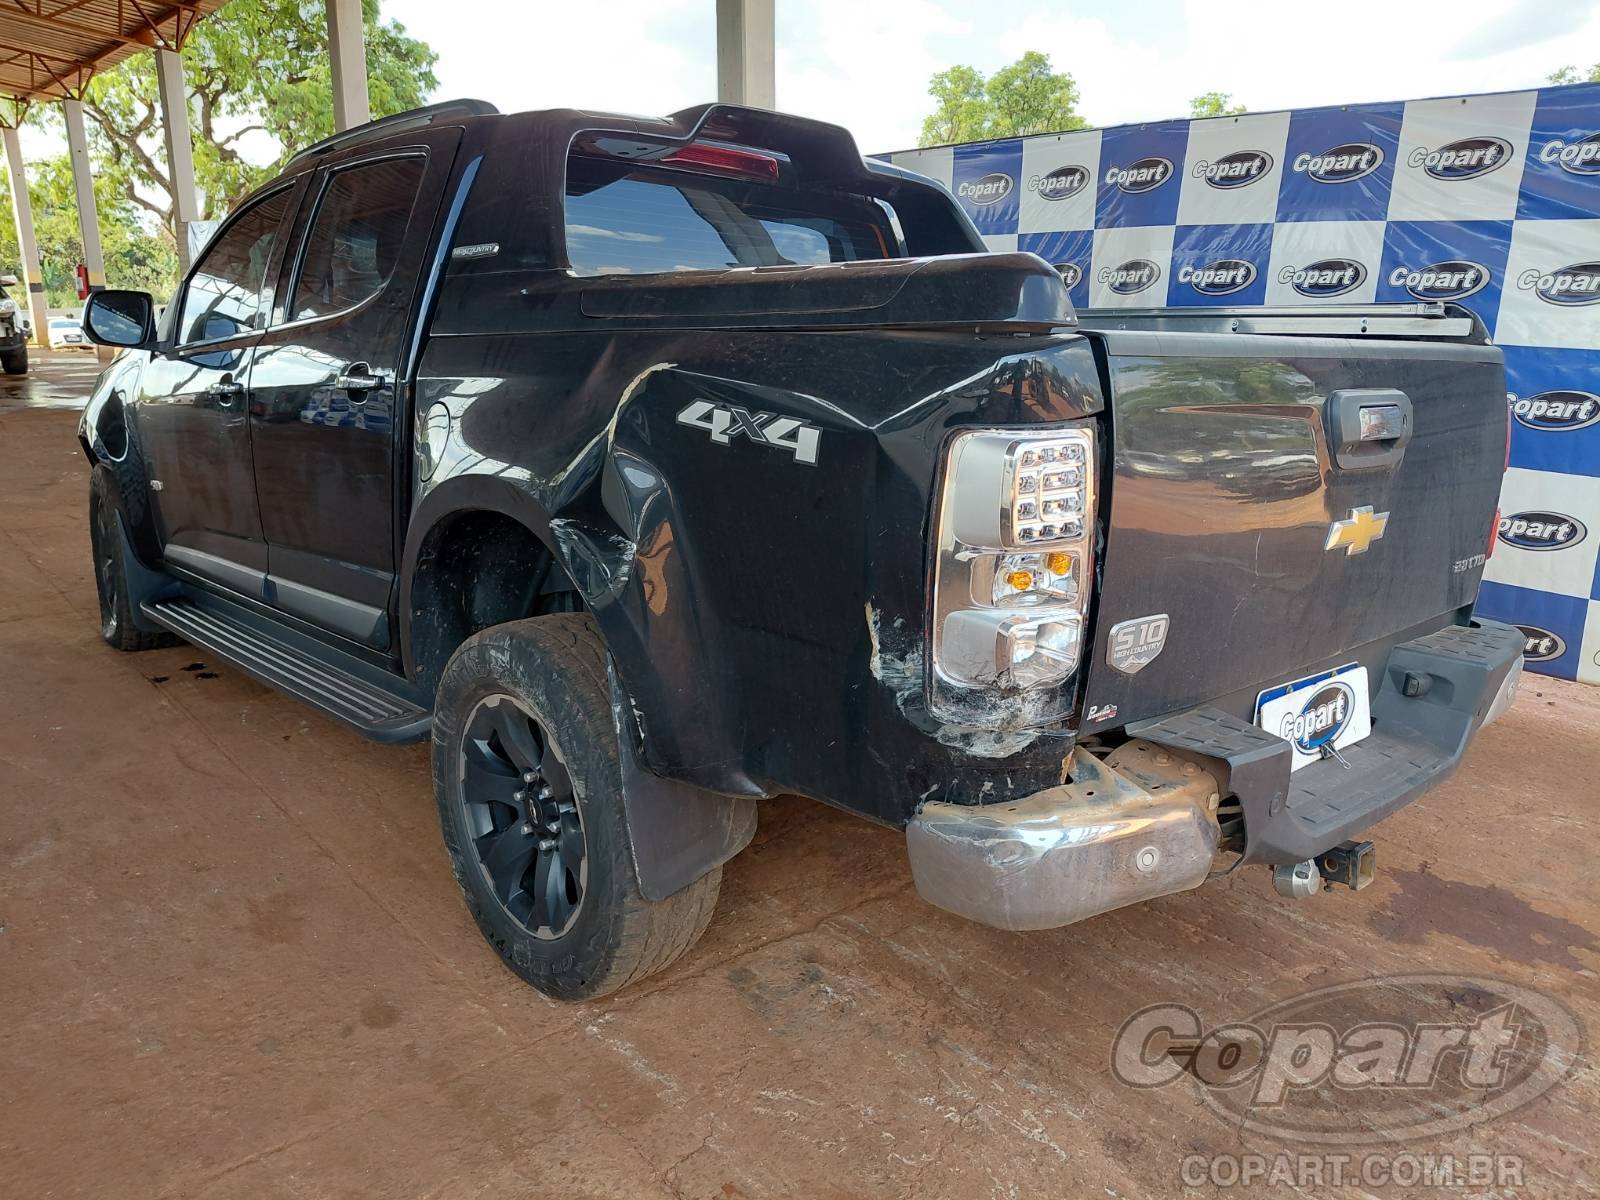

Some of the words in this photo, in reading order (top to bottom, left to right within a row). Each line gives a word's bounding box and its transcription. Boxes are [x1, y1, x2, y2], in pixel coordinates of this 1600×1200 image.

[1293, 147, 1373, 176] Copart
[1408, 141, 1499, 173] Copart
[1540, 139, 1600, 167] Cop
[1105, 161, 1166, 186] Copart
[1192, 157, 1262, 181] Copart
[958, 177, 1006, 198] Copart
[1027, 171, 1082, 196] Copart
[1098, 266, 1152, 291] Copart
[1178, 265, 1247, 288] Copart
[1278, 264, 1356, 289] Copart
[1389, 266, 1477, 292] Copart
[1517, 269, 1600, 295] Copar
[1499, 517, 1572, 542] opart
[1130, 642, 1161, 655] COUNTRY
[1281, 688, 1346, 748] Copart
